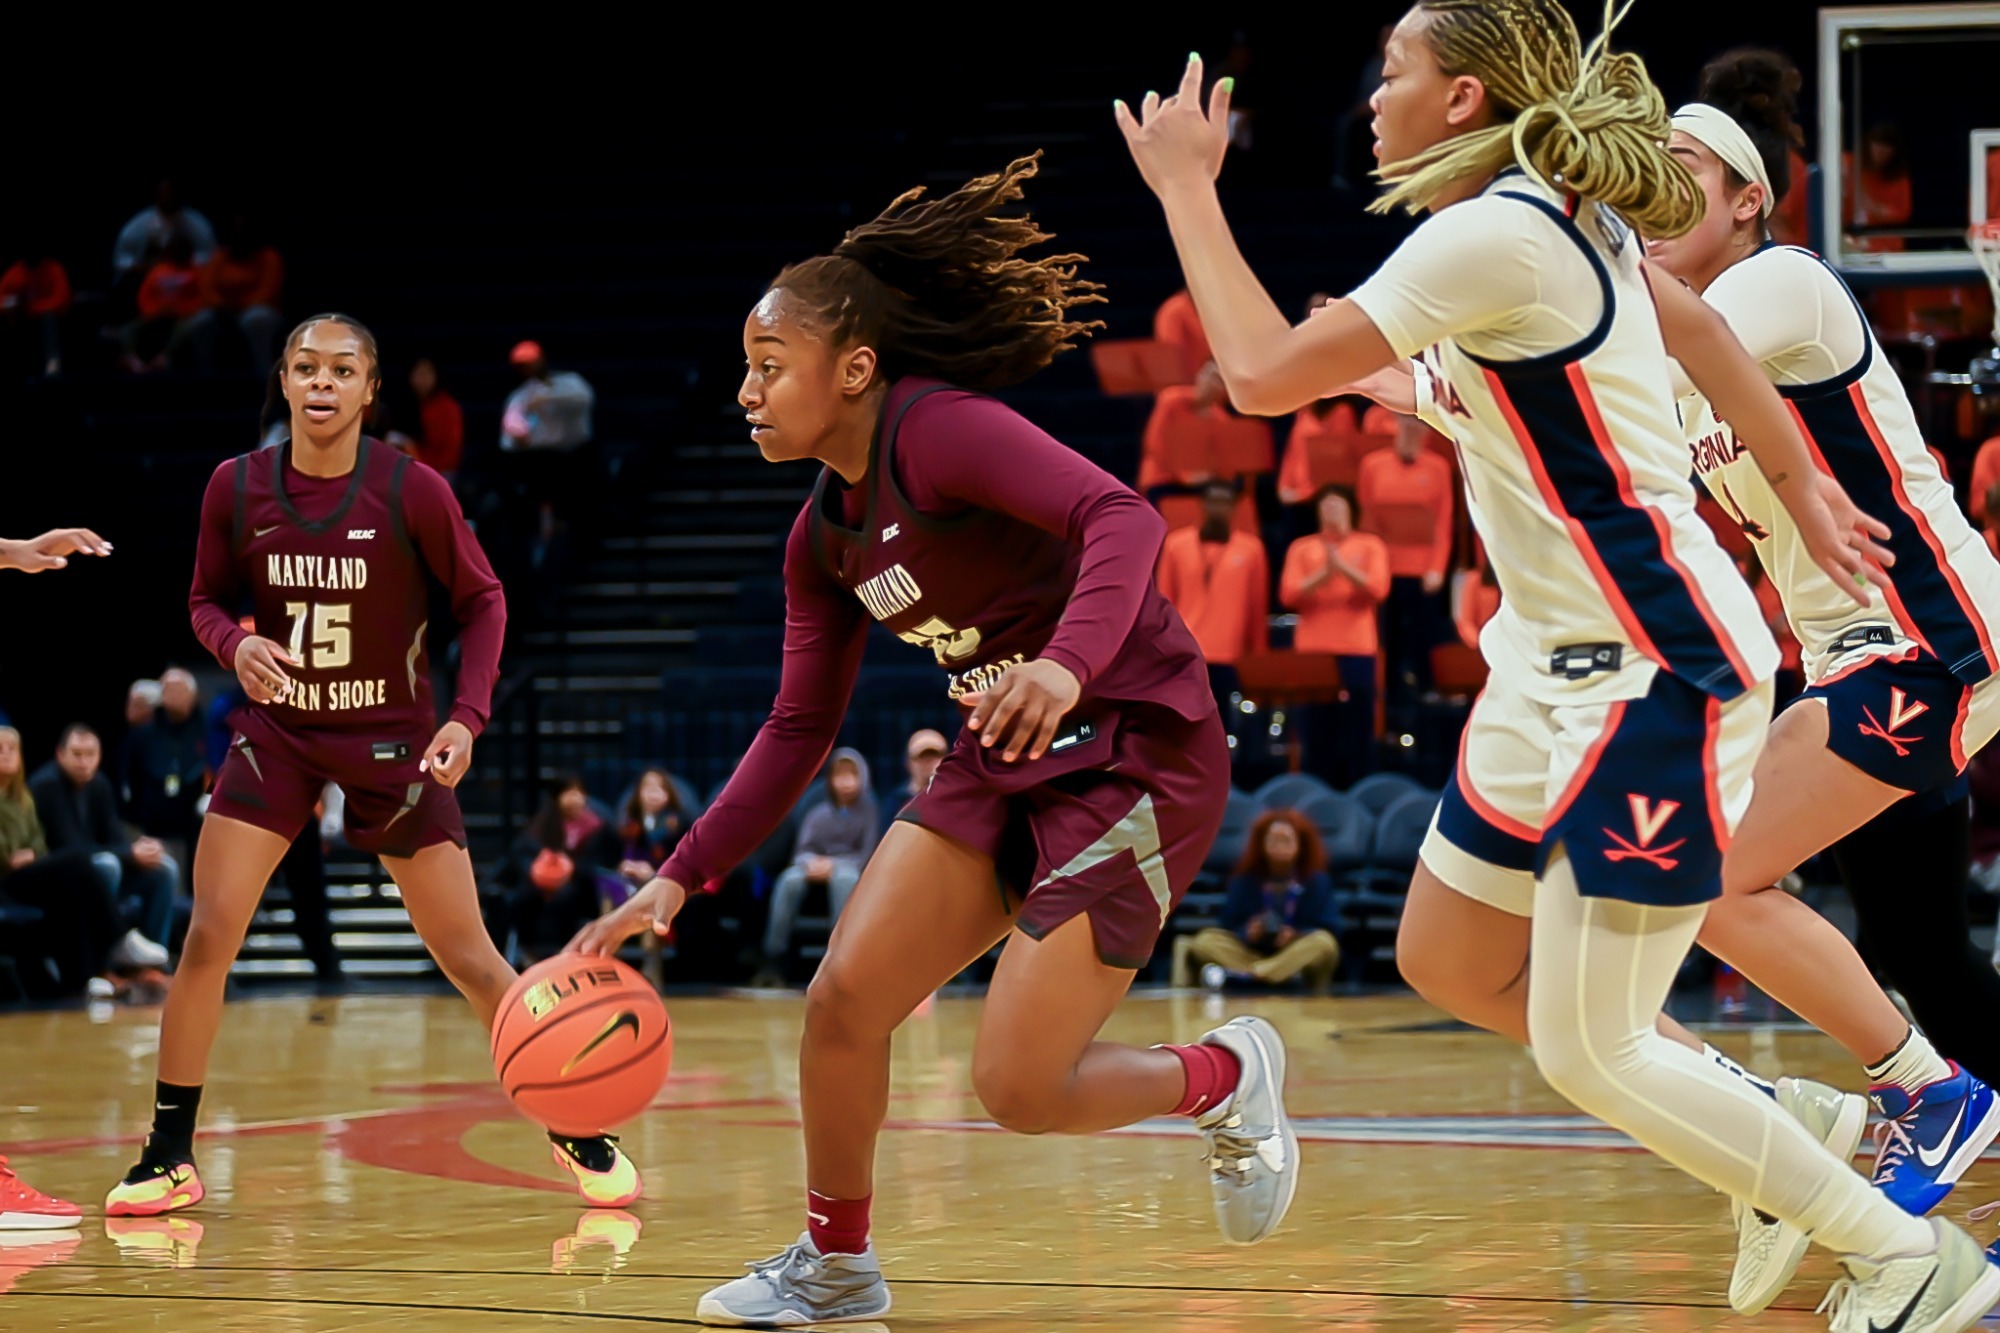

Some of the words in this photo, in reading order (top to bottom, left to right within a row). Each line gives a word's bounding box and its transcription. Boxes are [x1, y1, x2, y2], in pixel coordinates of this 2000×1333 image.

[1688, 430, 1748, 474] RGINIA
[268, 554, 367, 590] MARYLAND
[328, 679, 386, 711] SHORE
[1080, 724, 1091, 735] M
[1627, 793, 1681, 849] V
